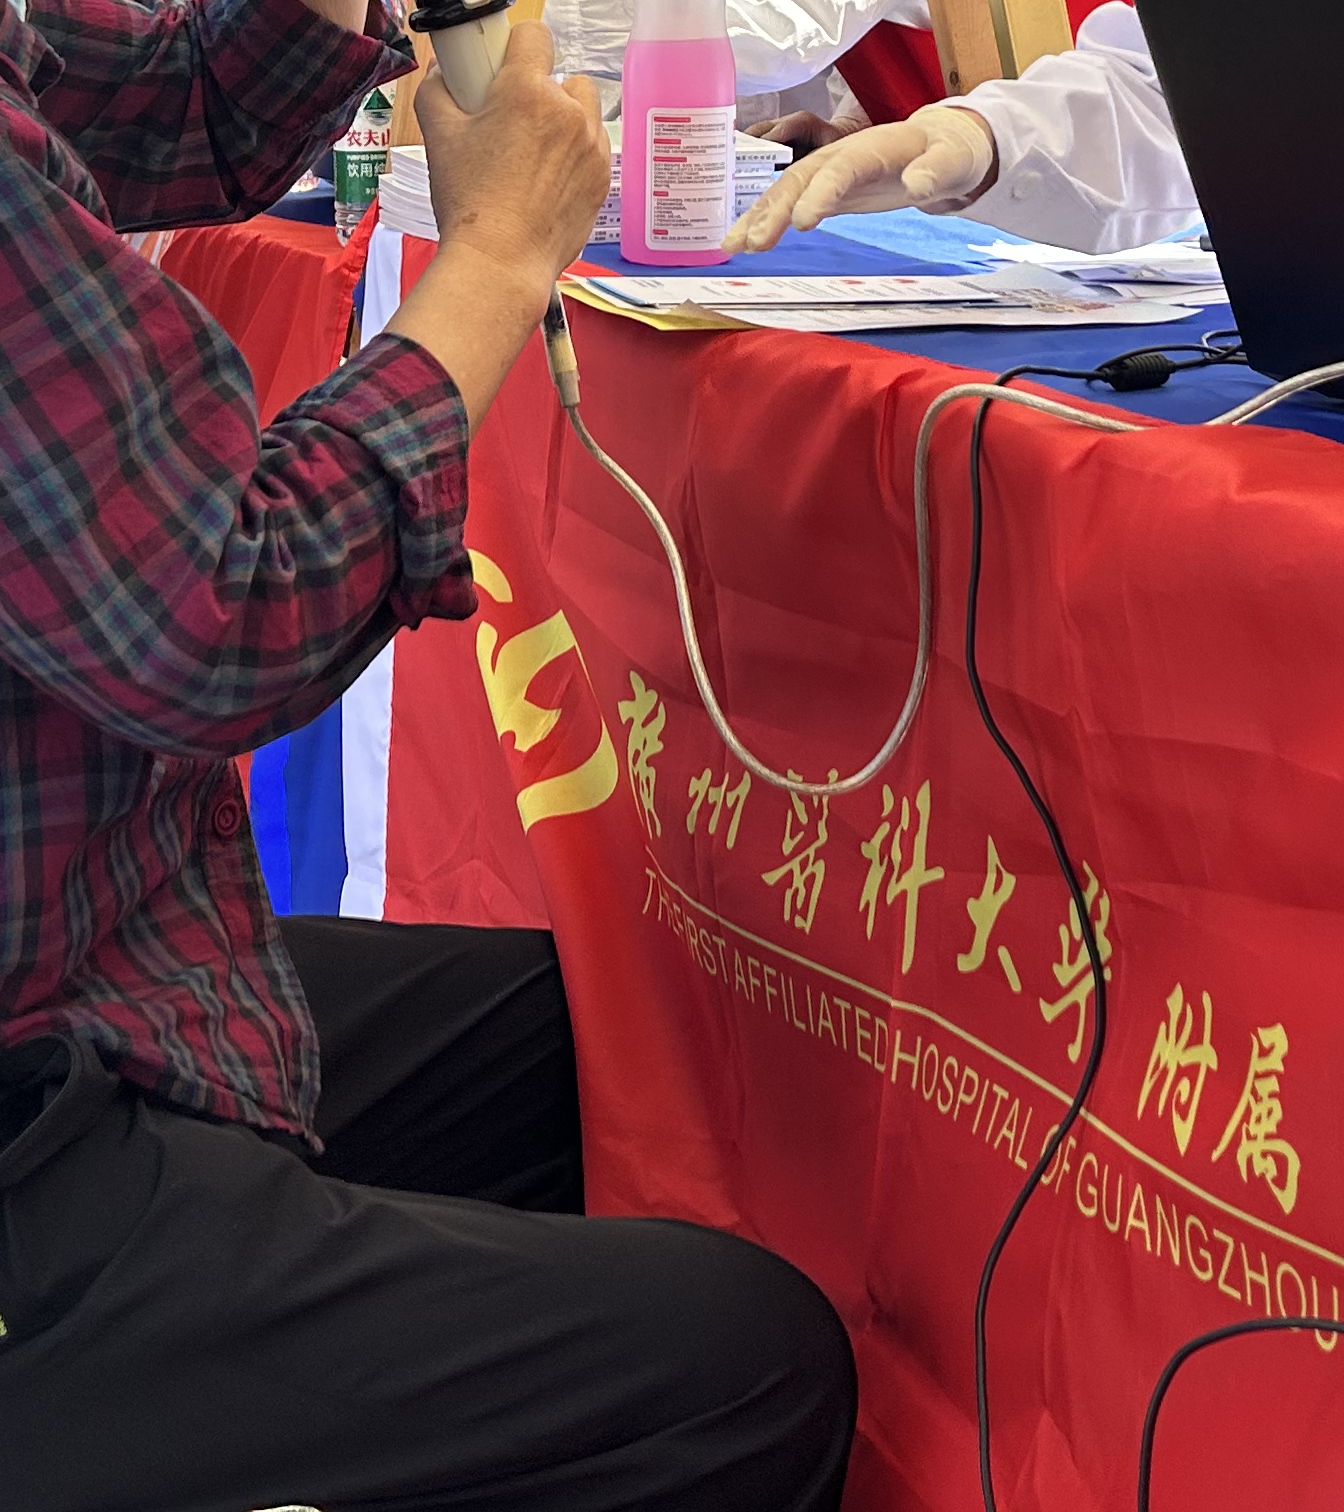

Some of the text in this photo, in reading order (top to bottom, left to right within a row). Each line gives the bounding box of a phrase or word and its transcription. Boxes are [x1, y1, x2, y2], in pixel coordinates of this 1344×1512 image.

[734, 947, 889, 1074] AFFILIATED
[891, 1029, 1034, 1170] HOSPITAL
[1075, 1151, 1339, 1352] GUANGZHOU
